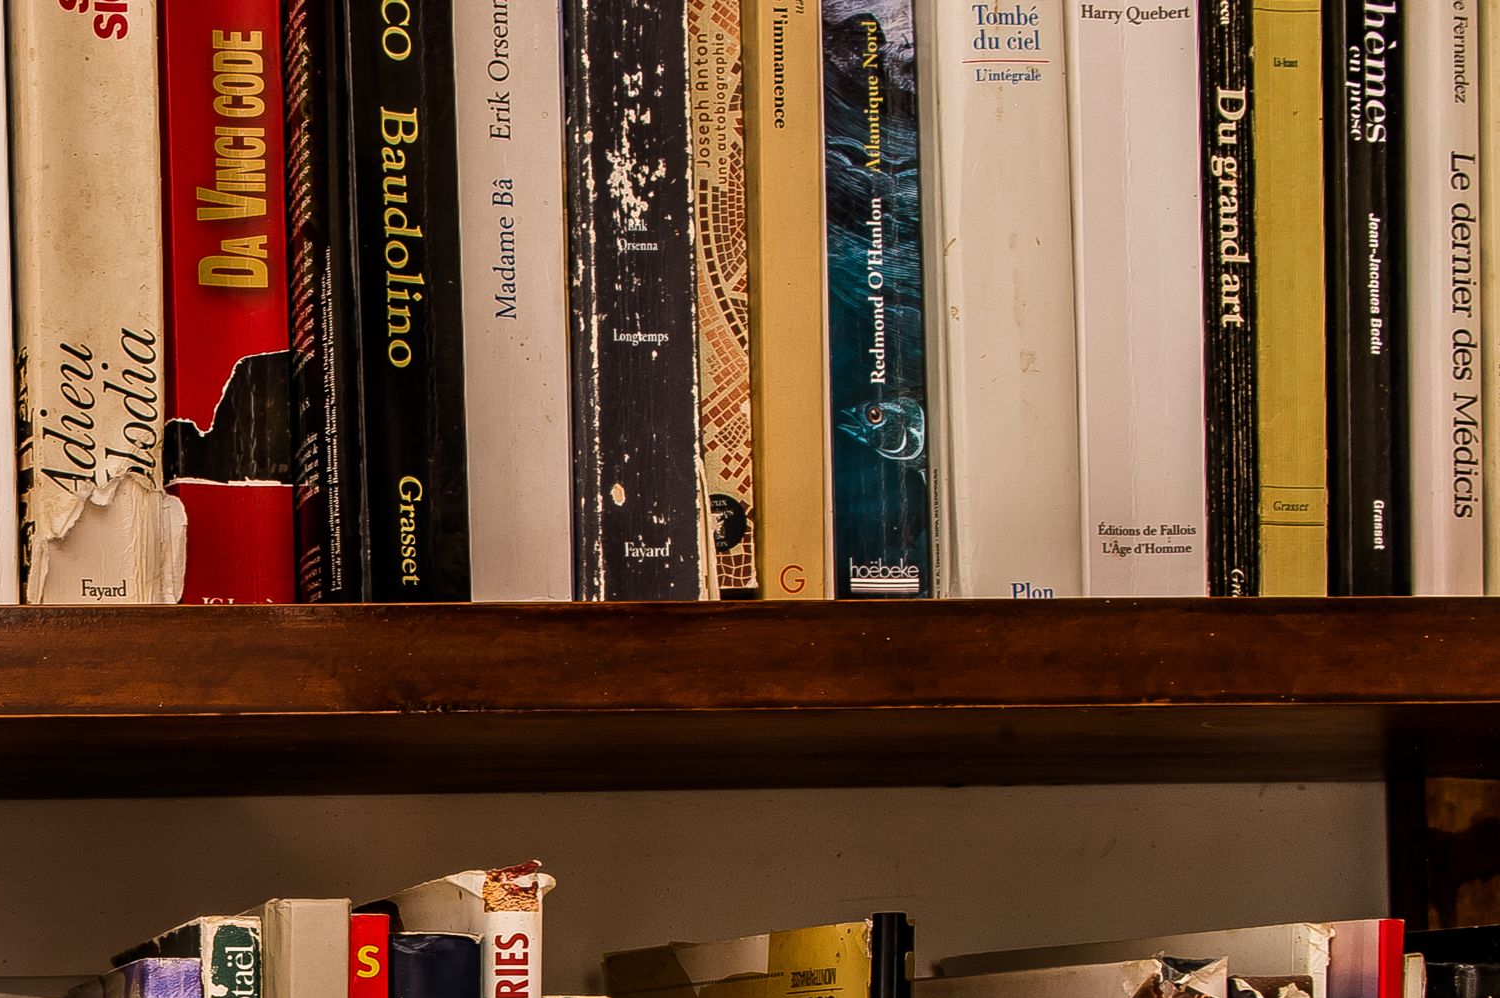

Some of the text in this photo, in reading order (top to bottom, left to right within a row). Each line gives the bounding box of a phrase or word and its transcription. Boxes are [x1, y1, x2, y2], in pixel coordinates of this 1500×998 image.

[972, 2, 1040, 27] Tombé
[973, 29, 1042, 52] du ciel
[1080, 3, 1124, 25] Harry
[1125, 4, 1192, 26] Quebert
[714, 33, 729, 152] autobiographie
[772, 6, 789, 130] l'immanence
[1344, 80, 1362, 142] prose
[195, 29, 269, 288] DA VINCI CODE
[486, 91, 518, 320] Madame Erik
[861, 20, 887, 385] Redmond Atlantique Nord
[379, 106, 426, 369] Baudolino
[617, 238, 659, 252] Orsenna
[1367, 212, 1382, 314] Jean-Jacques
[1450, 15, 1480, 519] Fernandez dernier des Médicis
[612, 328, 670, 347] Longtemps
[40, 342, 98, 495] Adieu
[398, 474, 424, 587] Grasset
[1097, 521, 1197, 537] Éditions Fallois
[1272, 501, 1310, 512] Grasset
[1373, 499, 1386, 550] Grasset
[81, 579, 128, 602] Fayard
[849, 557, 920, 579] hoëbeke
